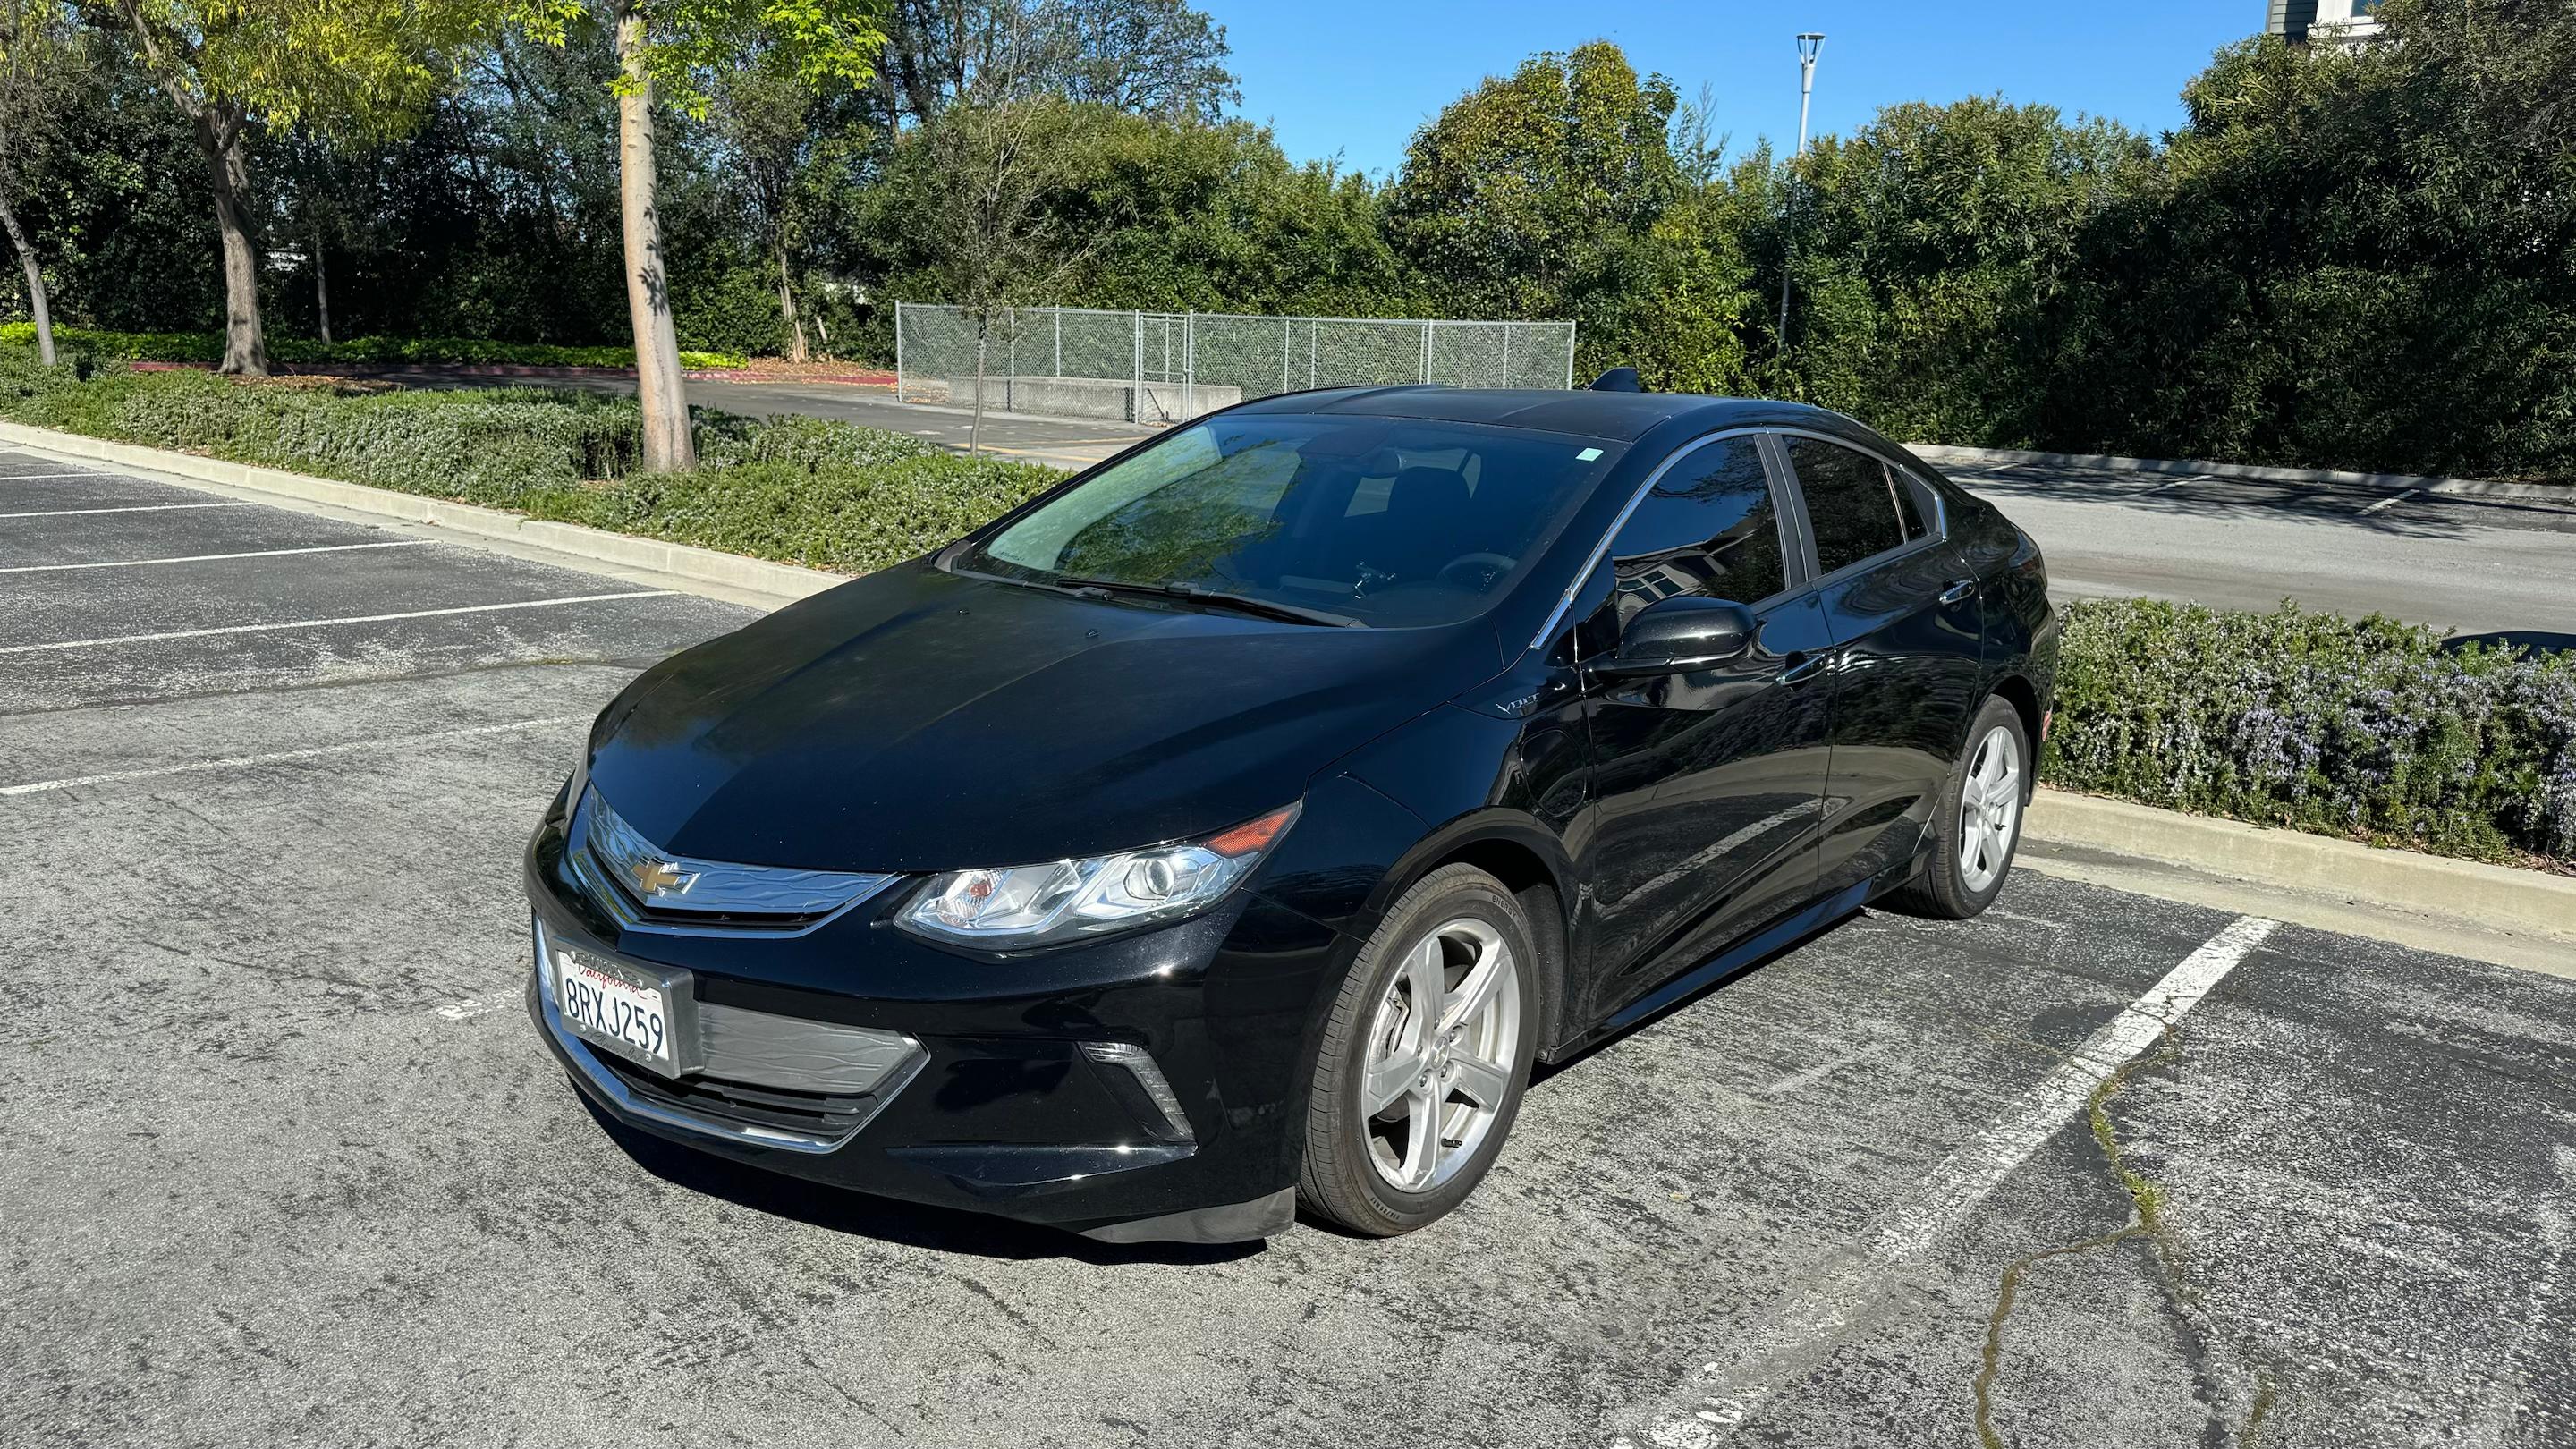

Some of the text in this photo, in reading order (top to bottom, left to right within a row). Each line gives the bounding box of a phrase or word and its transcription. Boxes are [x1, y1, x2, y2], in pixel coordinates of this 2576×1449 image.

[1495, 692, 1540, 715] VOLT
[1491, 894, 1517, 919] ENERGY
[565, 978, 663, 1054] 8RXJ259
